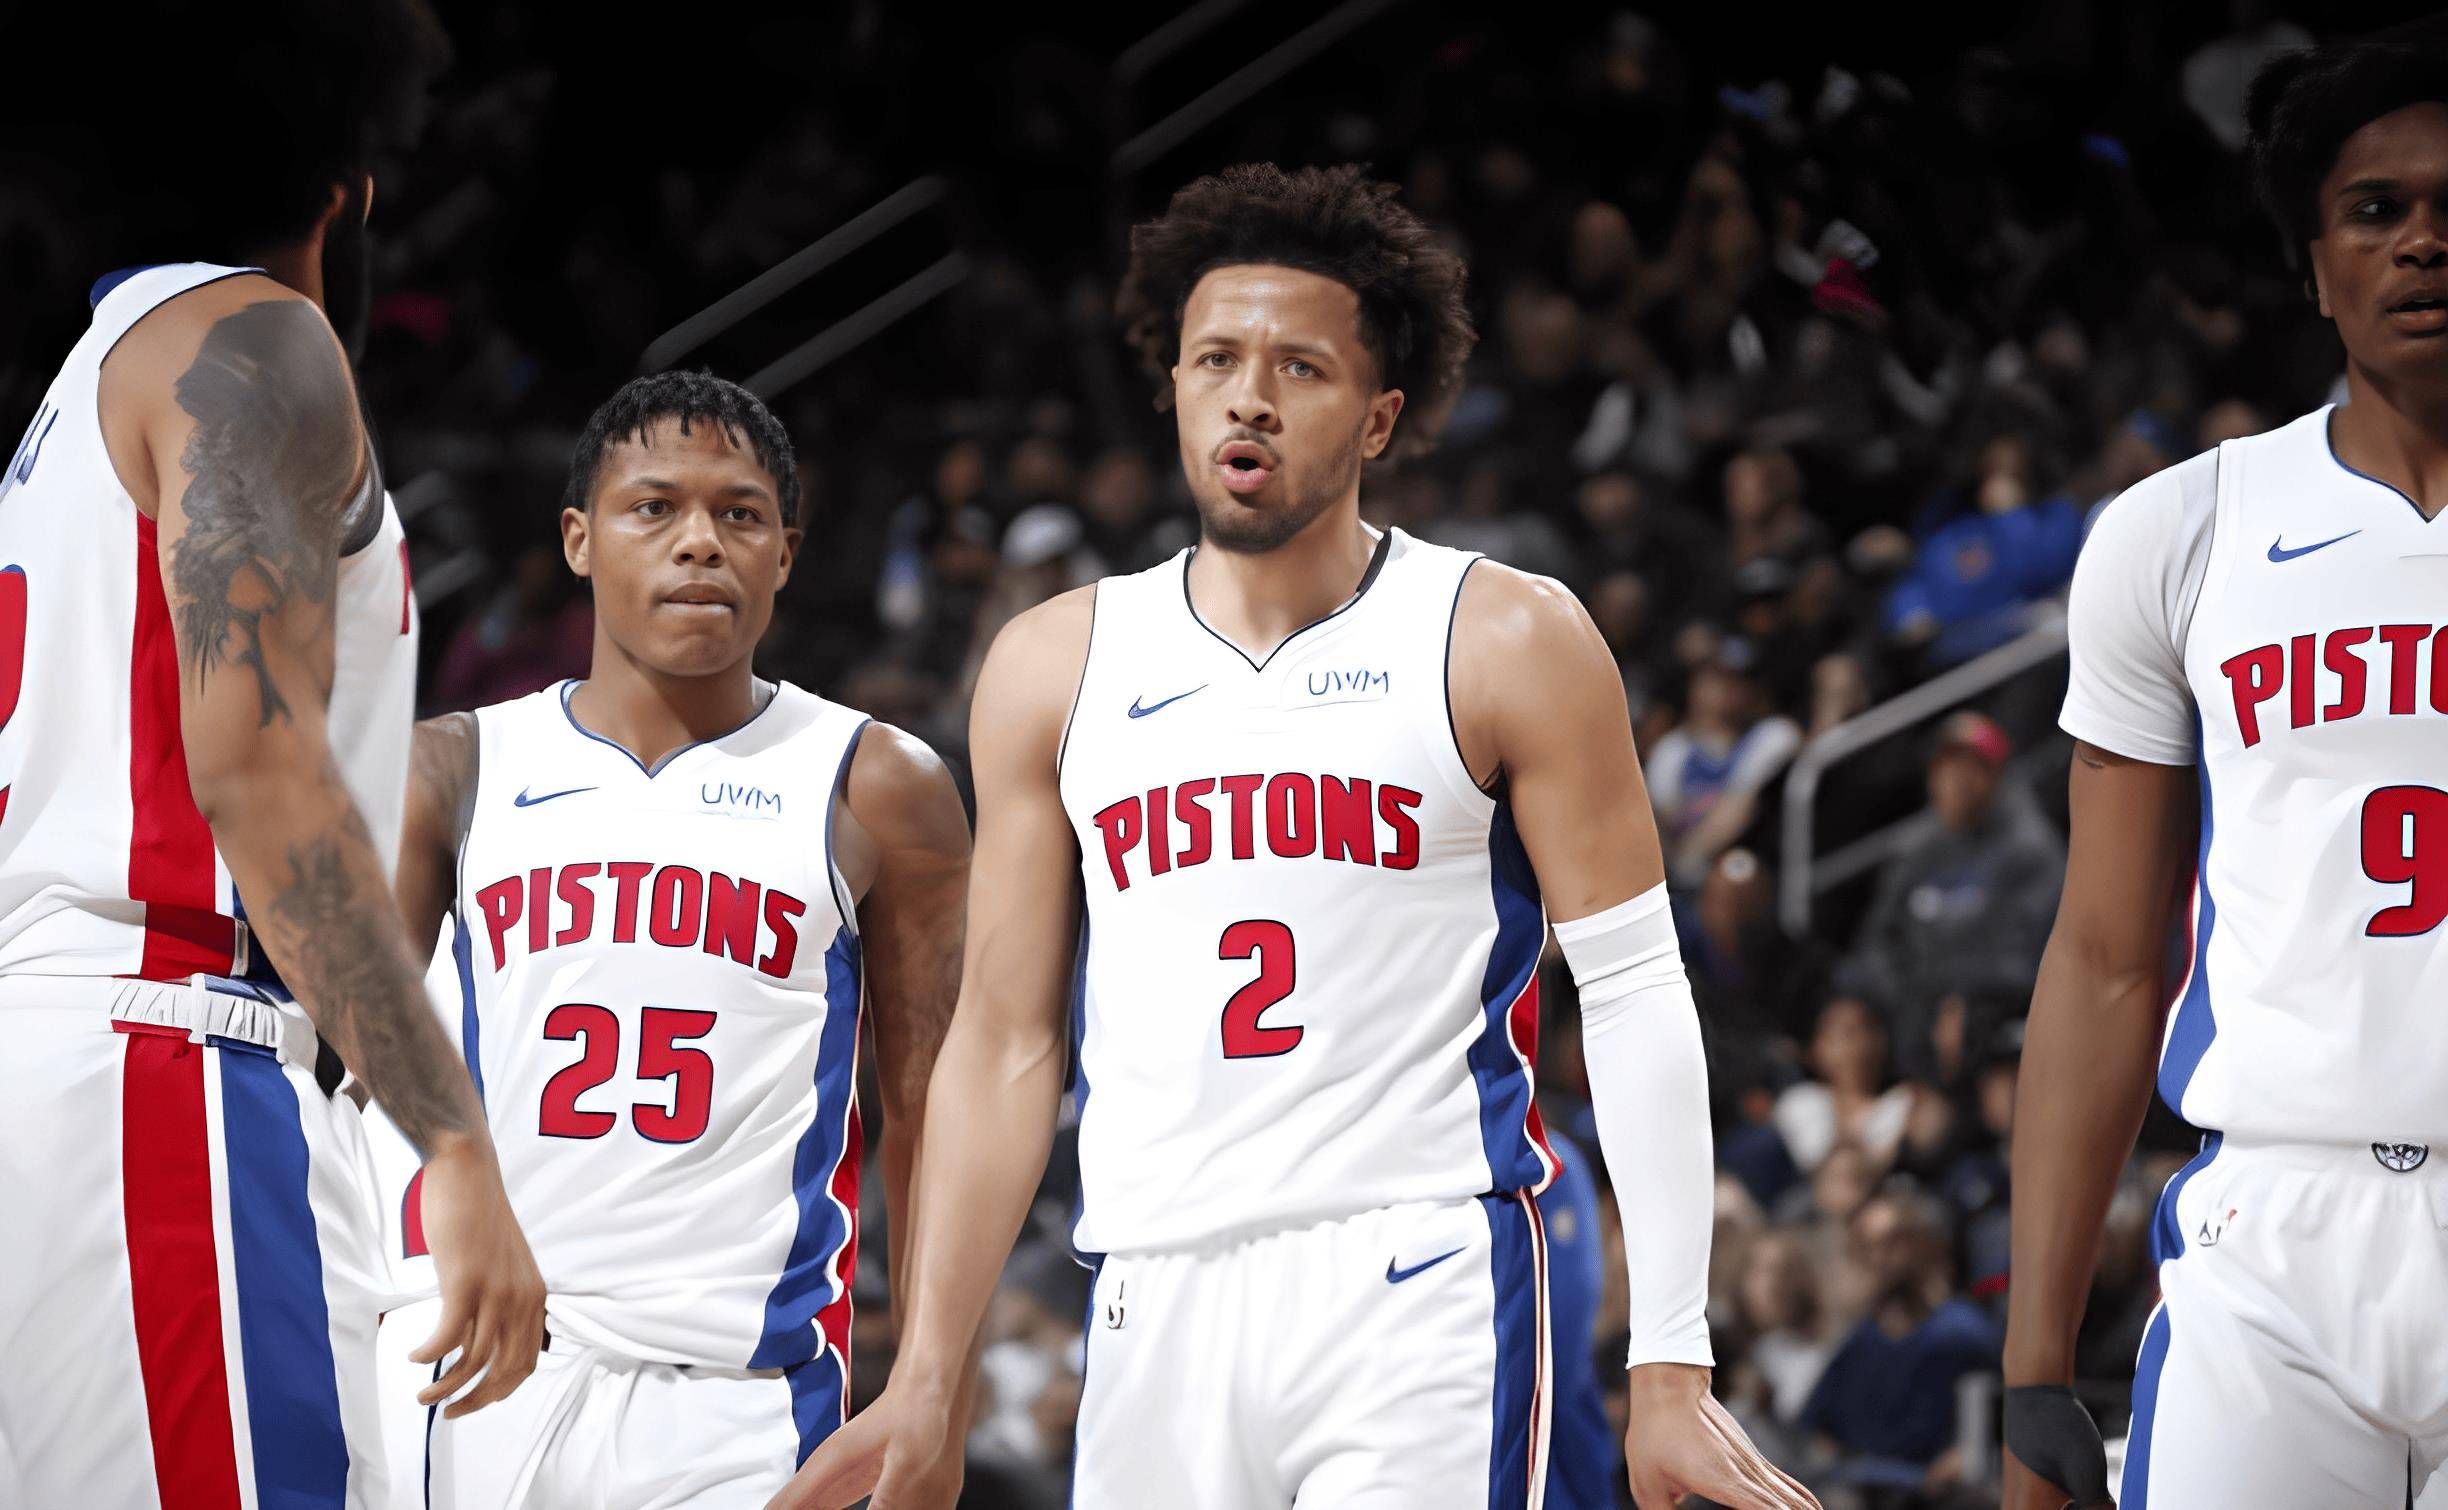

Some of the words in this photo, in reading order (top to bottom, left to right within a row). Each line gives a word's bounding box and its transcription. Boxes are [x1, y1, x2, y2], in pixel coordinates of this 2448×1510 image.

[1093, 772, 1424, 893] PISTONS
[2360, 784, 2448, 938] 9
[475, 862, 807, 979] PISTONS
[1218, 919, 1305, 1060] 2
[538, 1003, 718, 1145] 25
